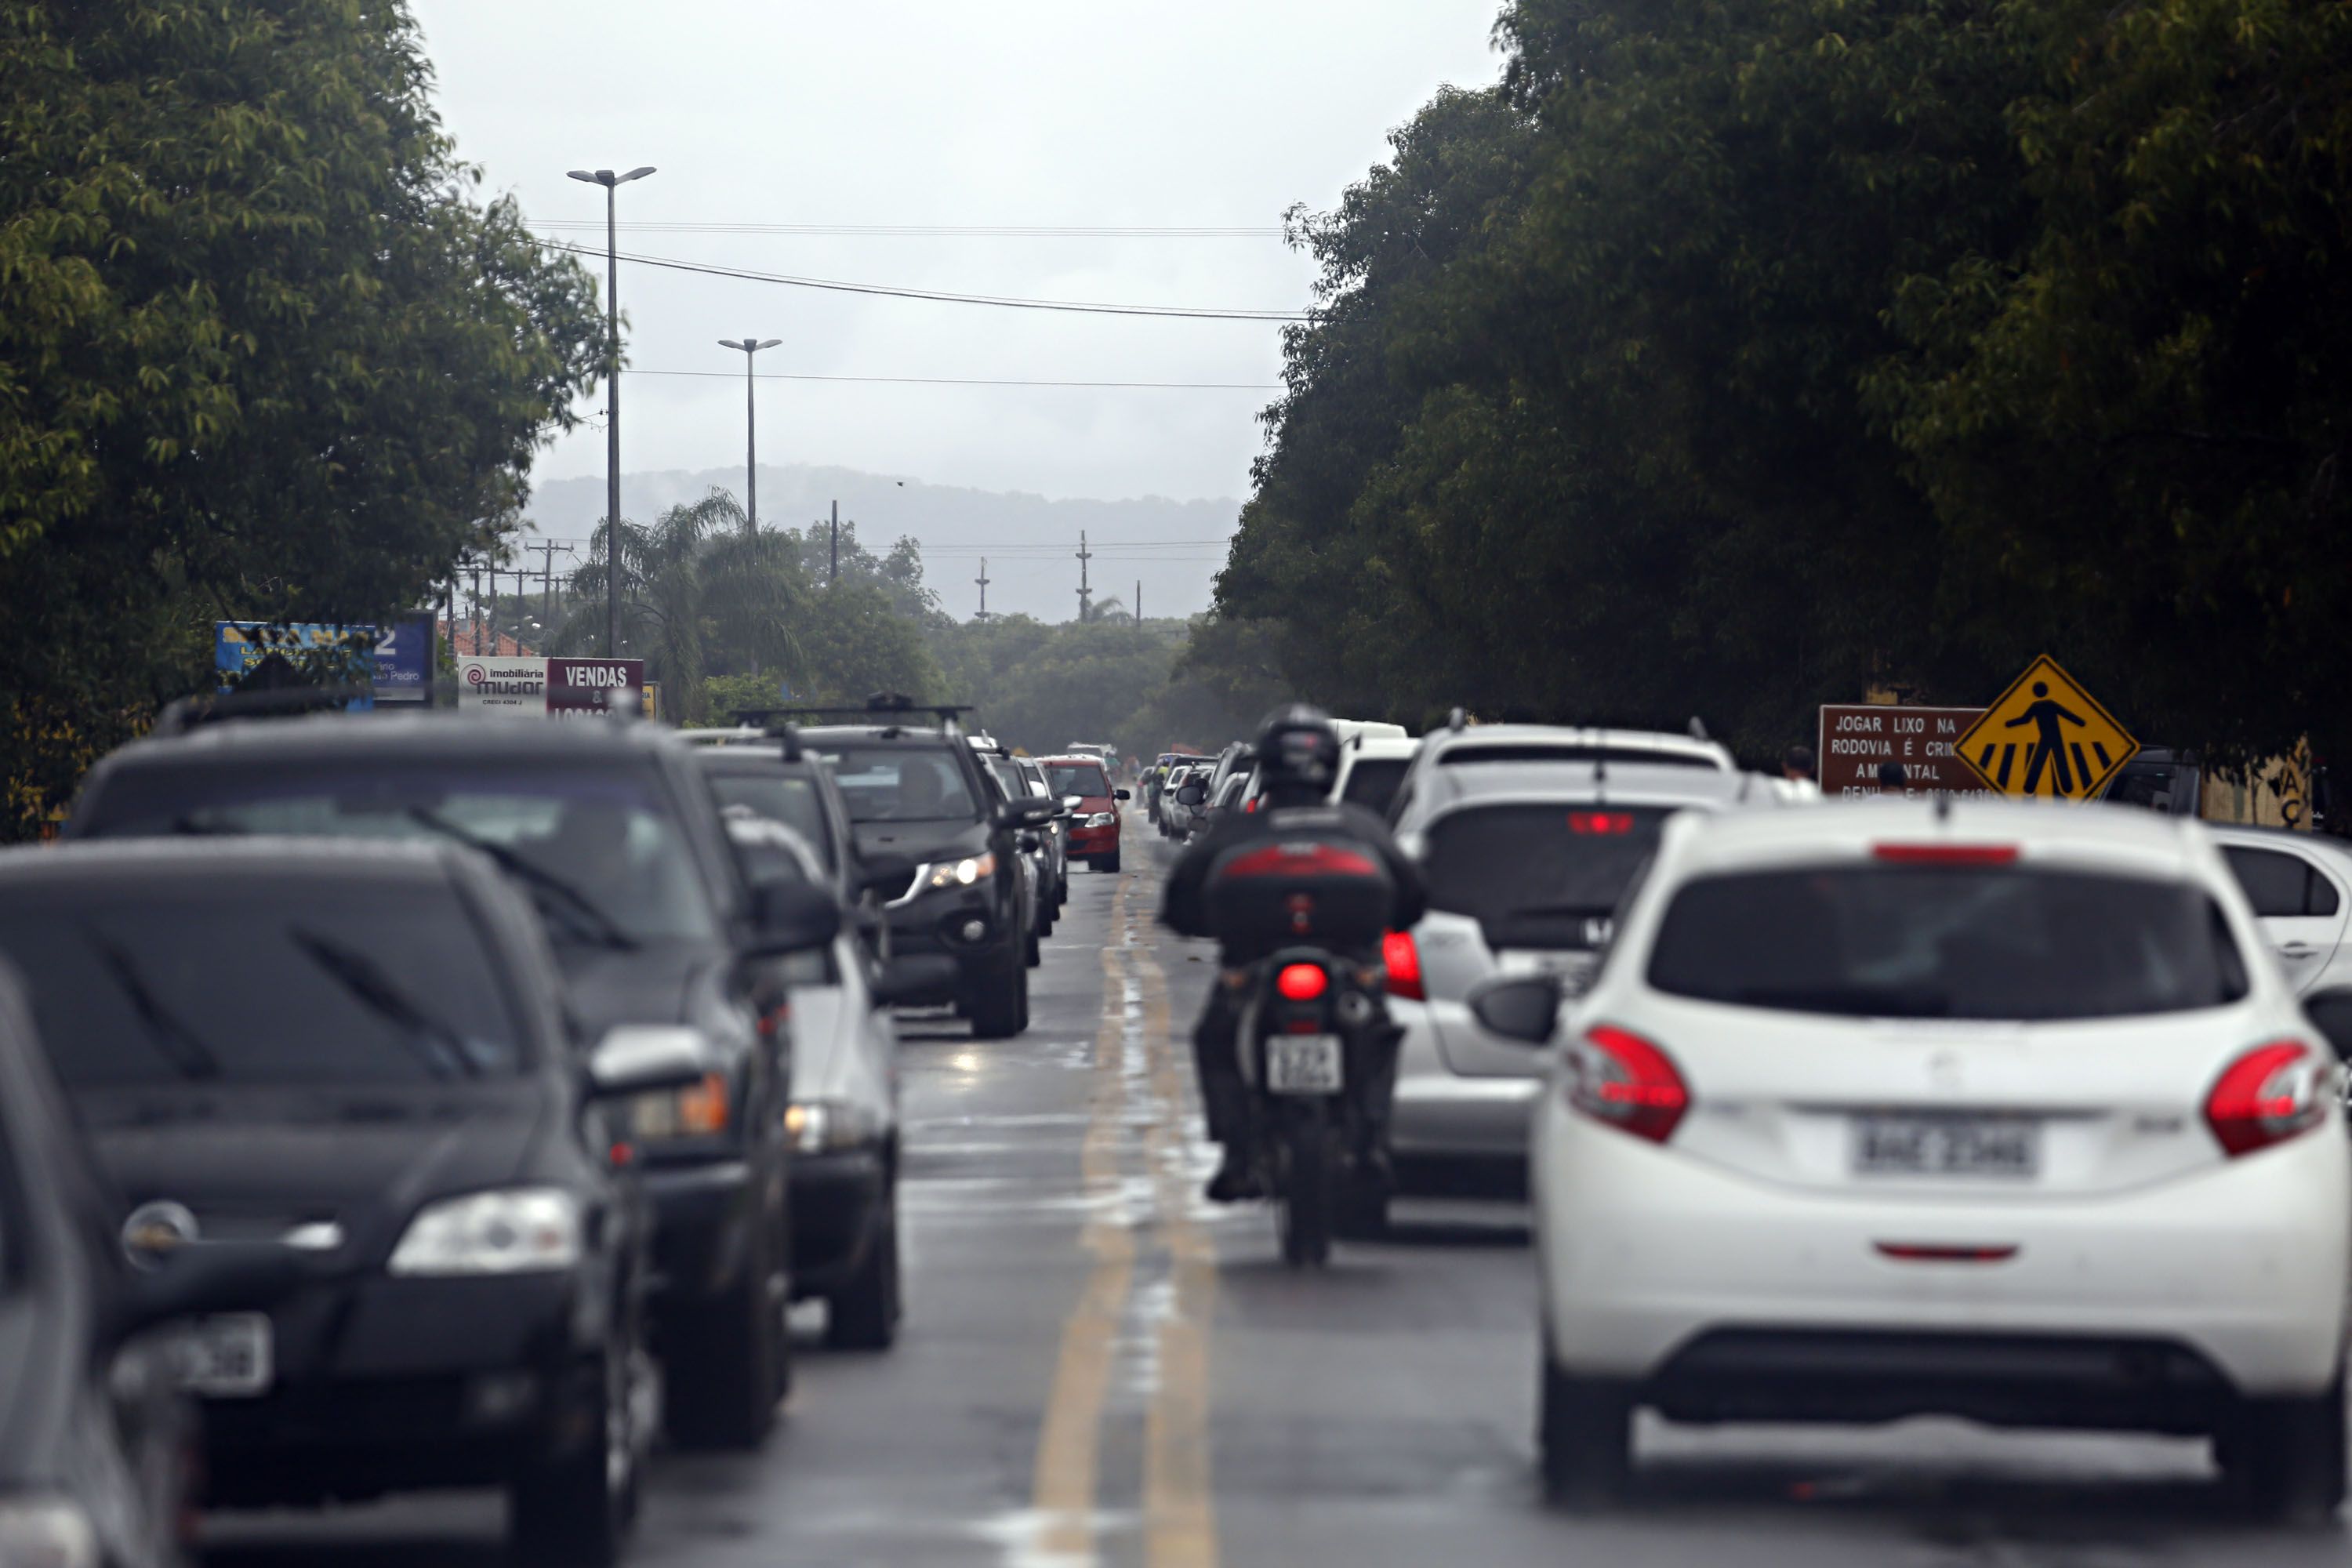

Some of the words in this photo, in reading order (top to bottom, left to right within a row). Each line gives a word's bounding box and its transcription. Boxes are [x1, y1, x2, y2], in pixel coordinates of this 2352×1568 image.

[390, 671, 419, 681] Pedro
[490, 669, 544, 678] imobiliária
[565, 666, 627, 688] VENDAS
[592, 690, 603, 704] &
[1835, 716, 1882, 732] JOGAR
[1893, 717, 1925, 734] LIXO
[1937, 718, 1956, 734] NA
[1831, 739, 1893, 756] RODOVIA
[1904, 738, 1913, 756] É
[1856, 763, 1940, 780] AMNTAL
